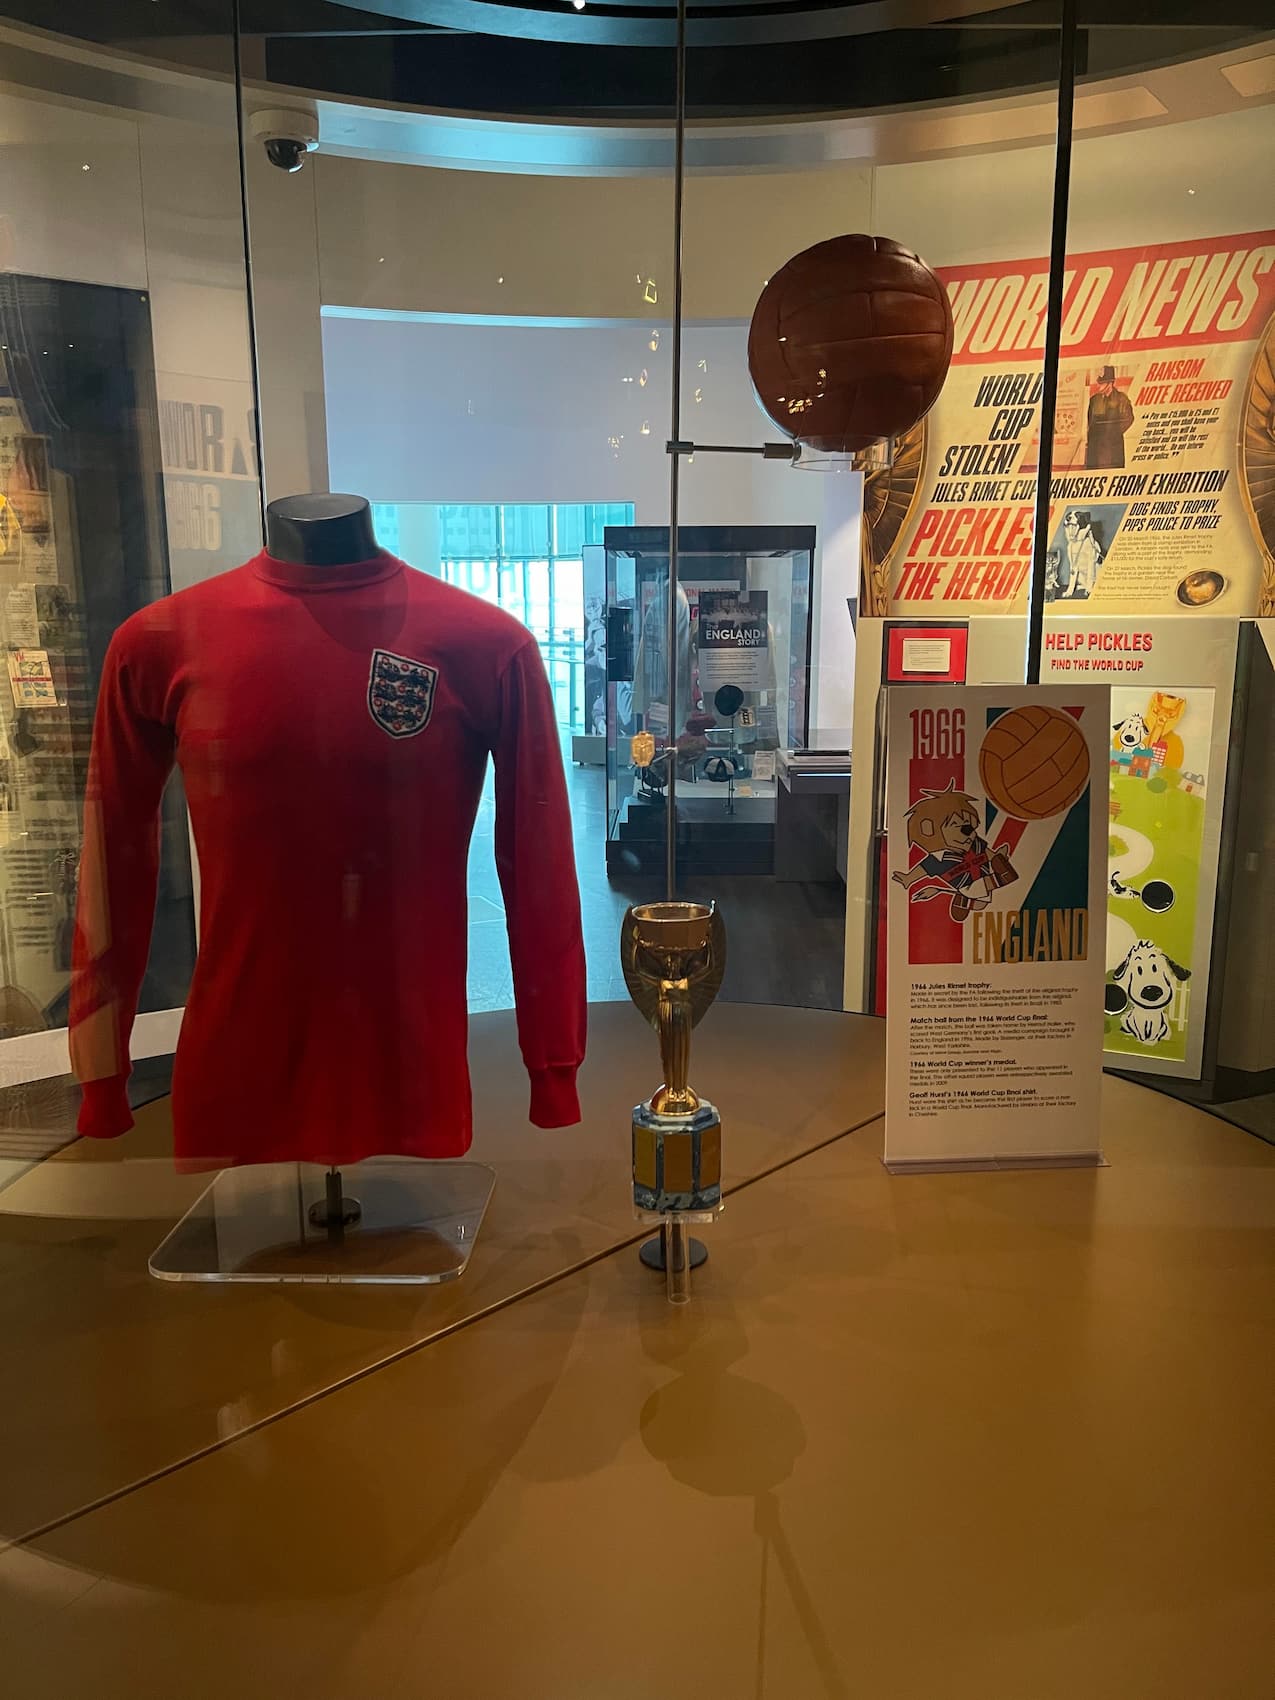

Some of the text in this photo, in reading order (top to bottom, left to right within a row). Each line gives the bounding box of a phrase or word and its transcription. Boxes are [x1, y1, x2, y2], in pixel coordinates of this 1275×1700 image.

[1101, 246, 1275, 343] NEWS
[1145, 358, 1205, 382] RANSOM
[1135, 379, 1233, 406] NOTE RECEIVED
[989, 408, 1035, 441] CUP
[939, 443, 1021, 477] STOLEN!
[931, 482, 969, 502] JULES
[969, 480, 1011, 502] RIMET
[1107, 474, 1149, 497] FROM
[1147, 470, 1230, 495] EXHIBITION
[1129, 502, 1150, 516] DOG
[1150, 501, 1179, 516] FINDS
[1122, 515, 1222, 532] PIPS POLICE TO PRIZE
[892, 560, 1031, 600] THE HERO!
[706, 629, 760, 640] ENGLAND
[1046, 632, 1152, 652] HELP PICKLES
[1051, 659, 1144, 672] FIND THE WORLD CUP
[909, 708, 966, 759] 1966
[972, 907, 1088, 964] ENGLAND
[1016, 1014, 1031, 1023] Cup
[947, 1060, 963, 1068] Cup
[990, 1090, 1005, 1098] Cup
